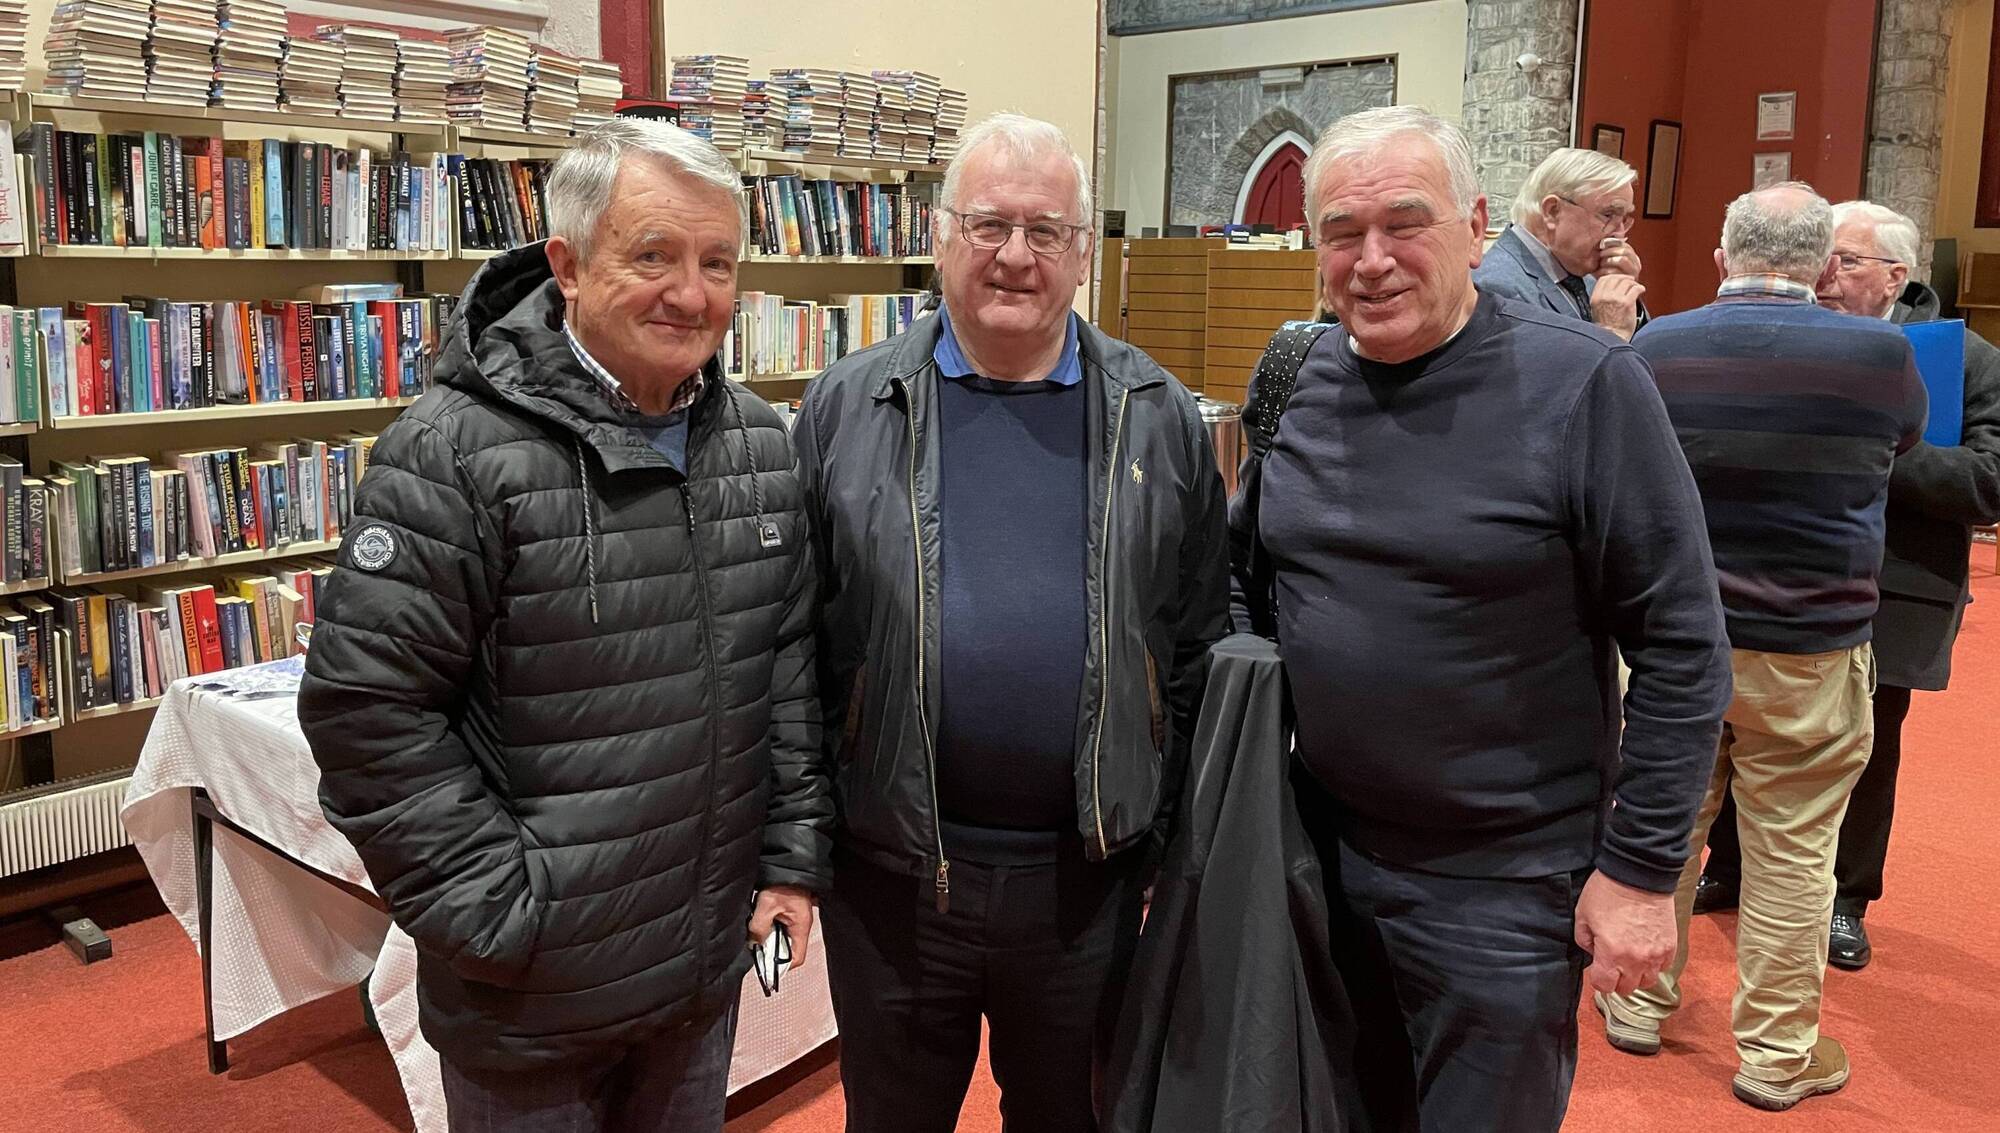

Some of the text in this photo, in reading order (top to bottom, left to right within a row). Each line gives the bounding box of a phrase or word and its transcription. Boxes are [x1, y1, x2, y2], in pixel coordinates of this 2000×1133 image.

[148, 150, 158, 172] JOHN
[162, 140, 171, 165] JOHN
[164, 167, 170, 176] le
[175, 163, 181, 172] LE
[361, 159, 369, 185] LUSTER
[459, 161, 470, 197] GUILTY
[321, 176, 331, 207] LEHANE
[176, 200, 184, 236] SILVERVIEW
[264, 320, 272, 335] THE
[440, 304, 449, 326] ROBERT
[191, 307, 202, 367] DEAR DAUGHTER
[299, 304, 315, 380] MISSING PERSON
[345, 320, 355, 345] LOVESEY
[360, 324, 368, 349] TRIVIA
[265, 335, 275, 365] HOLIDAY
[362, 350, 370, 375] NIGHT
[182, 370, 189, 380] ME
[206, 371, 214, 398] LIPPMAN
[238, 454, 248, 491] MACBRIDE
[243, 459, 251, 484] STUART
[7, 496, 16, 526] MICHAEL
[14, 489, 22, 506] HOW
[139, 468, 153, 532] THE RISING TIDE
[222, 463, 240, 540] STUART MACBRIDE
[15, 508, 22, 517] IT
[241, 498, 251, 526] DEAD
[30, 489, 44, 570] KRAY SURVIVOR
[127, 501, 137, 552] BLACK SNOW
[76, 601, 89, 655] STUART MACBRIDE
[181, 595, 198, 650] MIDNIGHT
